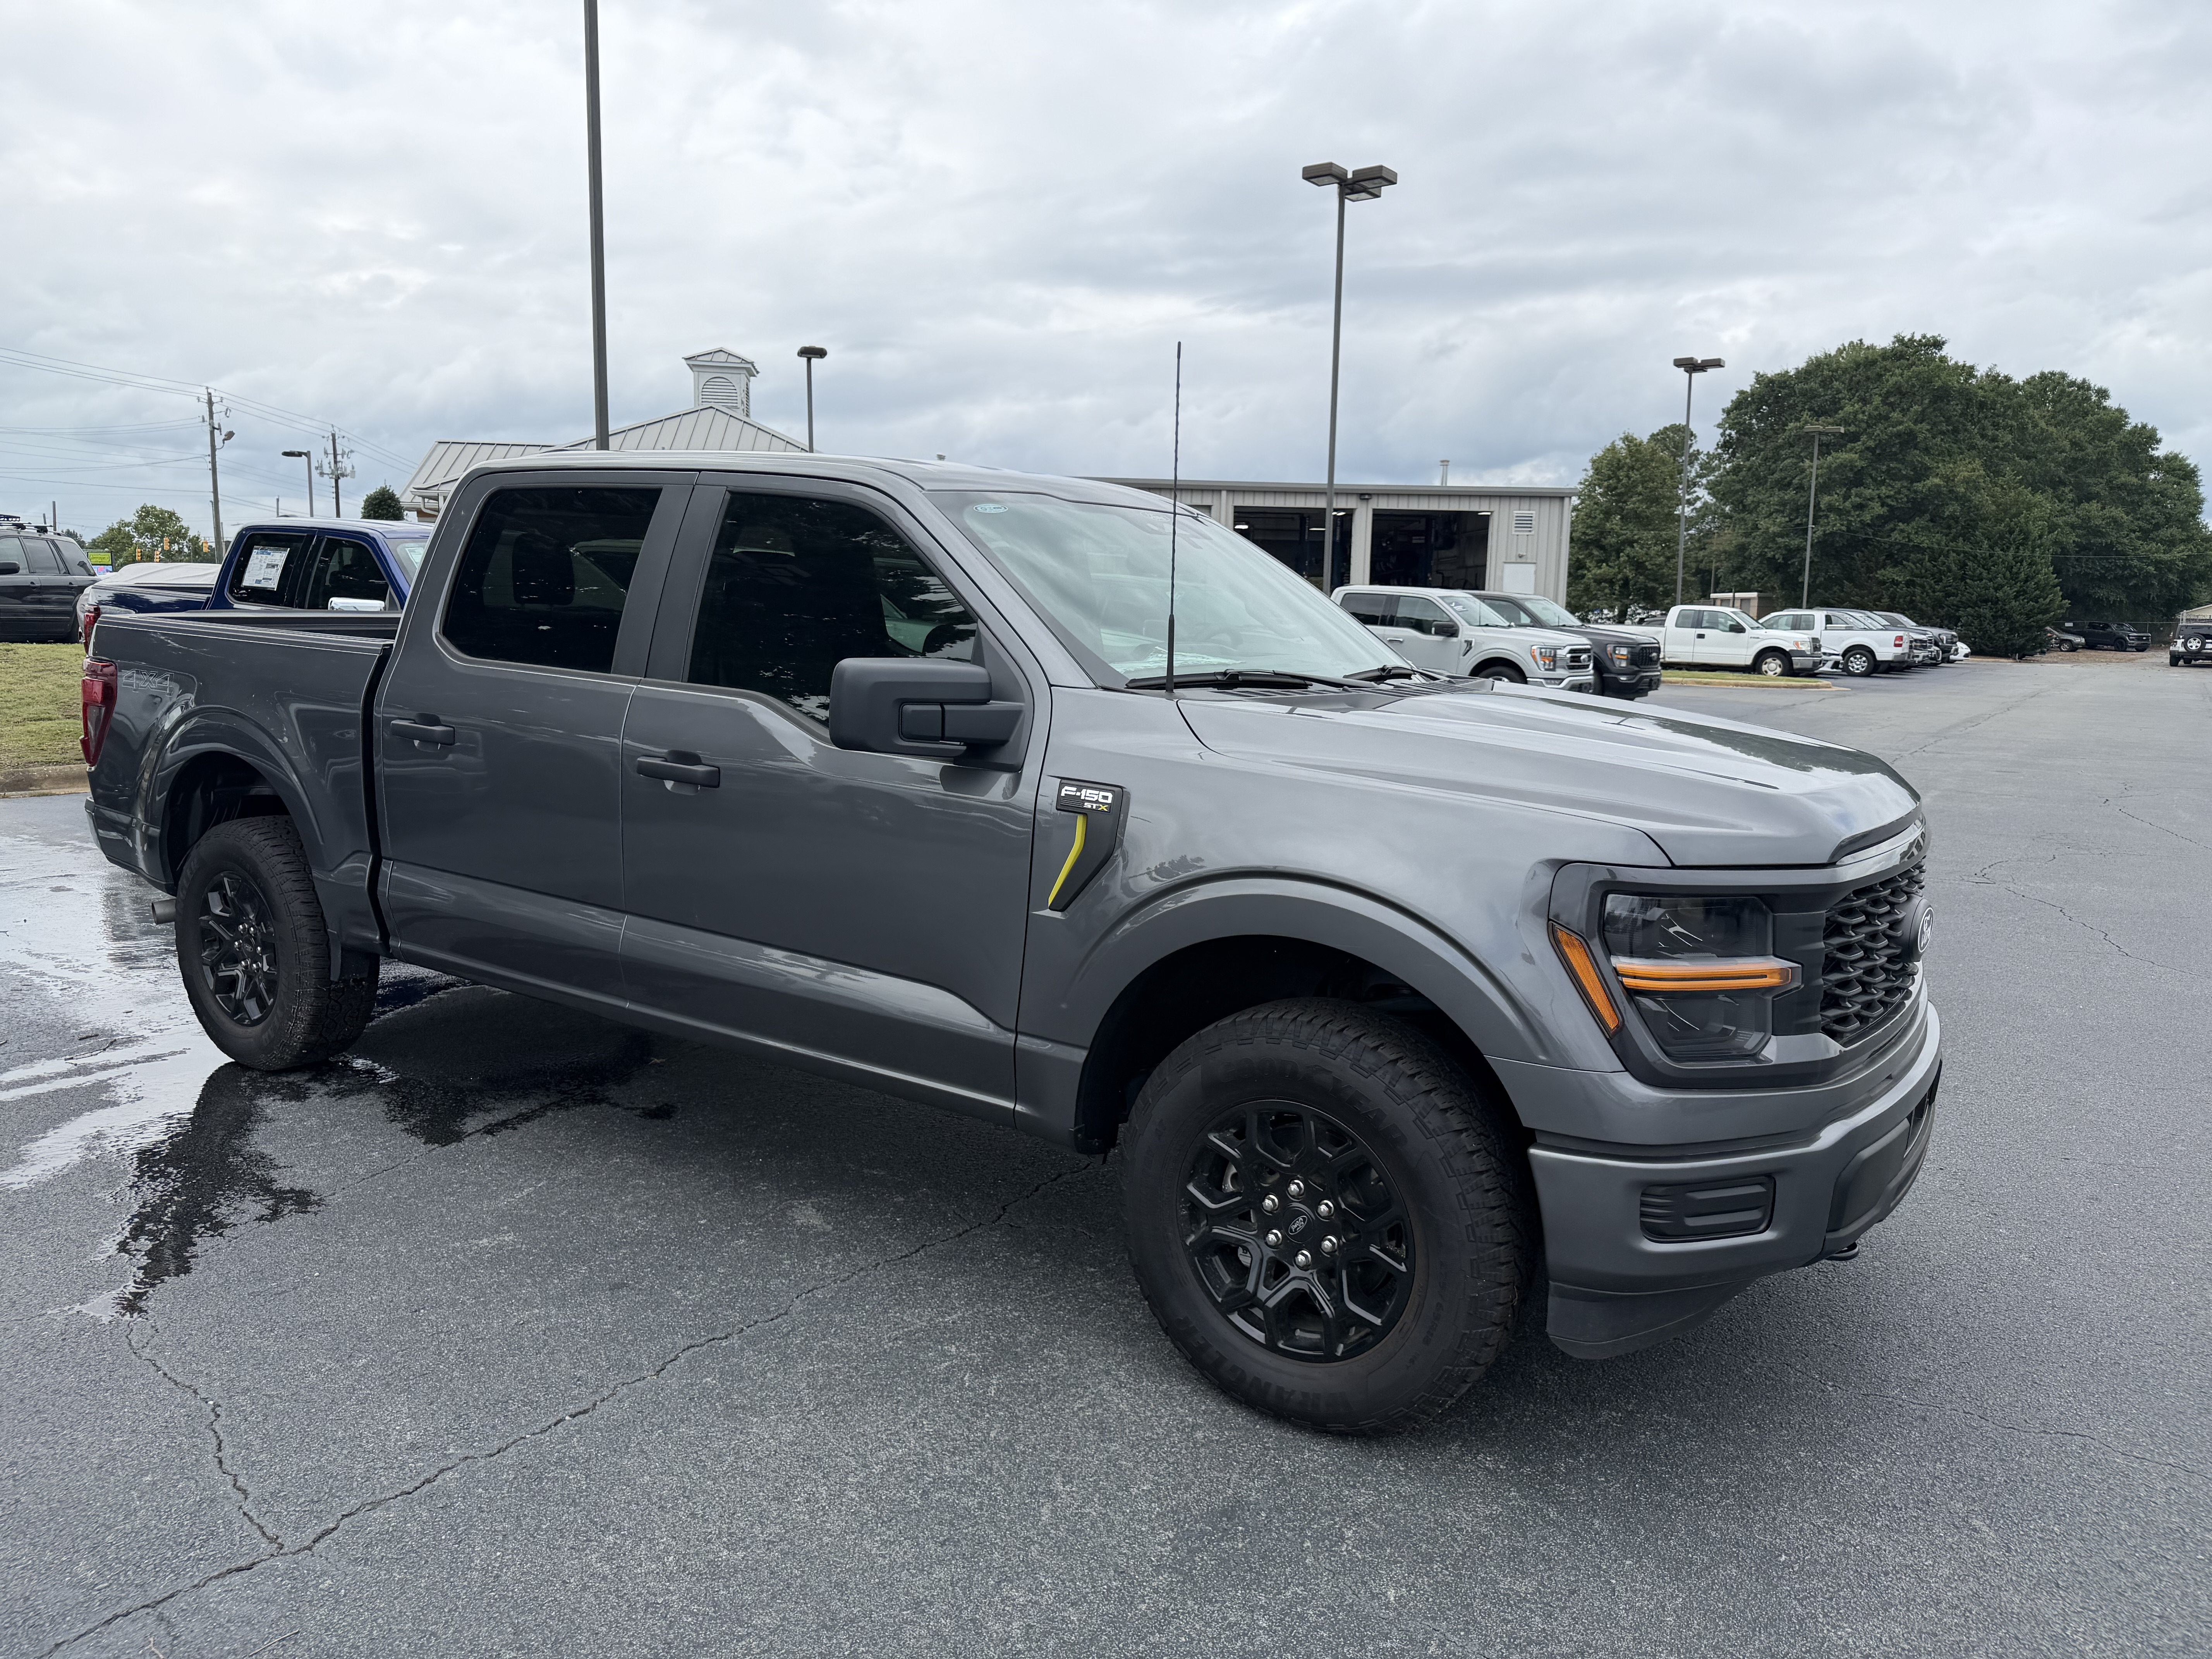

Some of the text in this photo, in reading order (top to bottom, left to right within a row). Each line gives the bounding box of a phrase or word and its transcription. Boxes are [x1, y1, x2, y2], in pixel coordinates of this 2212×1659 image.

[1061, 786, 1113, 804] F-150
[1083, 802, 1109, 811] STX
[1290, 1217, 1305, 1233] Ford
